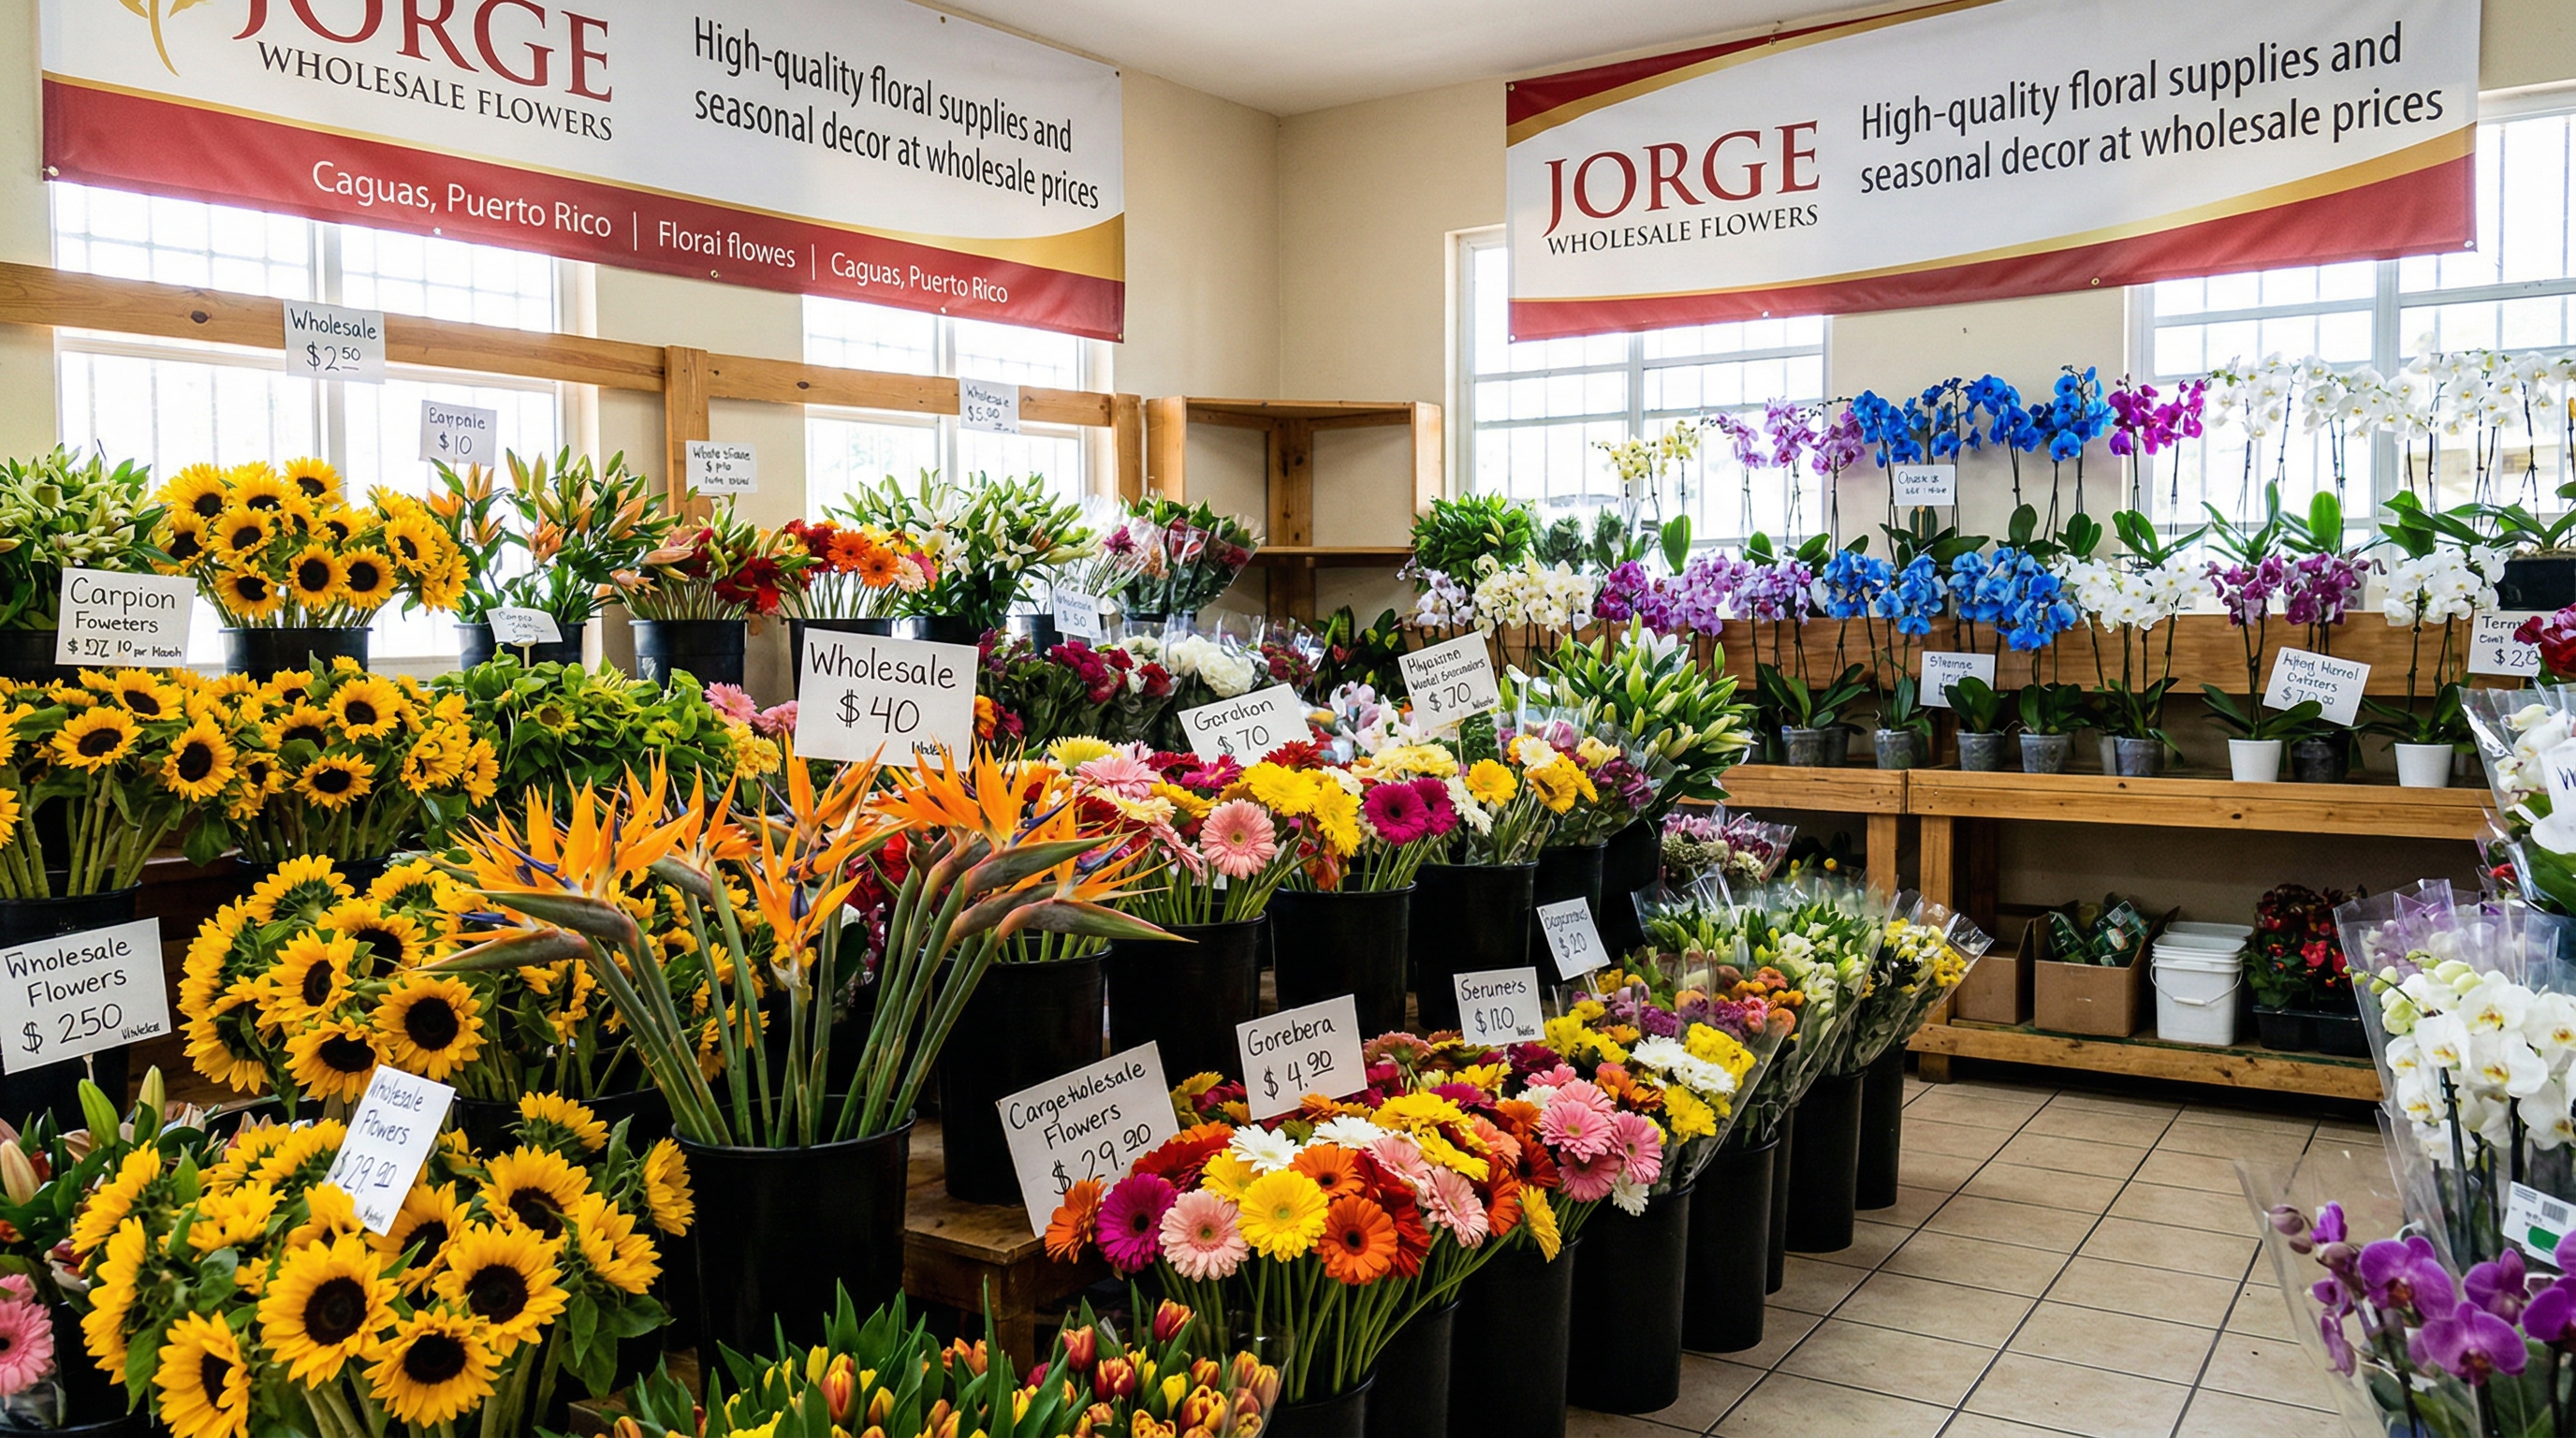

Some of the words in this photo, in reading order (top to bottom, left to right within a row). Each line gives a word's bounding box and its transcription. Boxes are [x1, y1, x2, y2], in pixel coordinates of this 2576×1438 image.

[256, 41, 466, 110] WHOLESALE
[476, 91, 613, 141] FLOWERS
[694, 15, 865, 102] High-quality
[870, 64, 932, 117] floral
[939, 90, 1028, 142] supplies
[1033, 119, 1072, 154] and
[1861, 79, 2059, 146] High-quality
[2069, 60, 2157, 111] floral
[2169, 41, 2320, 98] supplies
[2332, 21, 2403, 71] and
[695, 88, 813, 144] seasonal
[822, 111, 890, 162] decor
[897, 137, 921, 169] at
[926, 139, 1036, 198] wholesale
[1041, 170, 1100, 211] prices
[1860, 140, 1990, 194] seasonal
[2002, 136, 2089, 175] decor
[2099, 126, 2131, 163] at
[2141, 99, 2320, 157] wholesale
[2332, 87, 2444, 143] prices
[312, 160, 437, 214] Caguas,
[446, 184, 547, 227] Puerto
[555, 202, 612, 238] Rico
[1542, 119, 1822, 238] JORGE
[727, 232, 796, 269] flowes
[1547, 220, 1691, 256] WHOLESALE
[1699, 203, 1819, 240] FLOWERS
[831, 251, 905, 290] Caguas,
[910, 265, 968, 298] Puerto
[972, 276, 1009, 305] Rico
[290, 307, 377, 340] Wholesale
[70, 577, 175, 615] Carpion
[76, 610, 158, 633] Foweters
[810, 642, 956, 689] Wholesale
[27, 969, 127, 1008] Flowers
[1248, 1019, 1336, 1056] Gorebera
[358, 1109, 411, 1146] Flowers
[1044, 1104, 1121, 1150] Flowers
